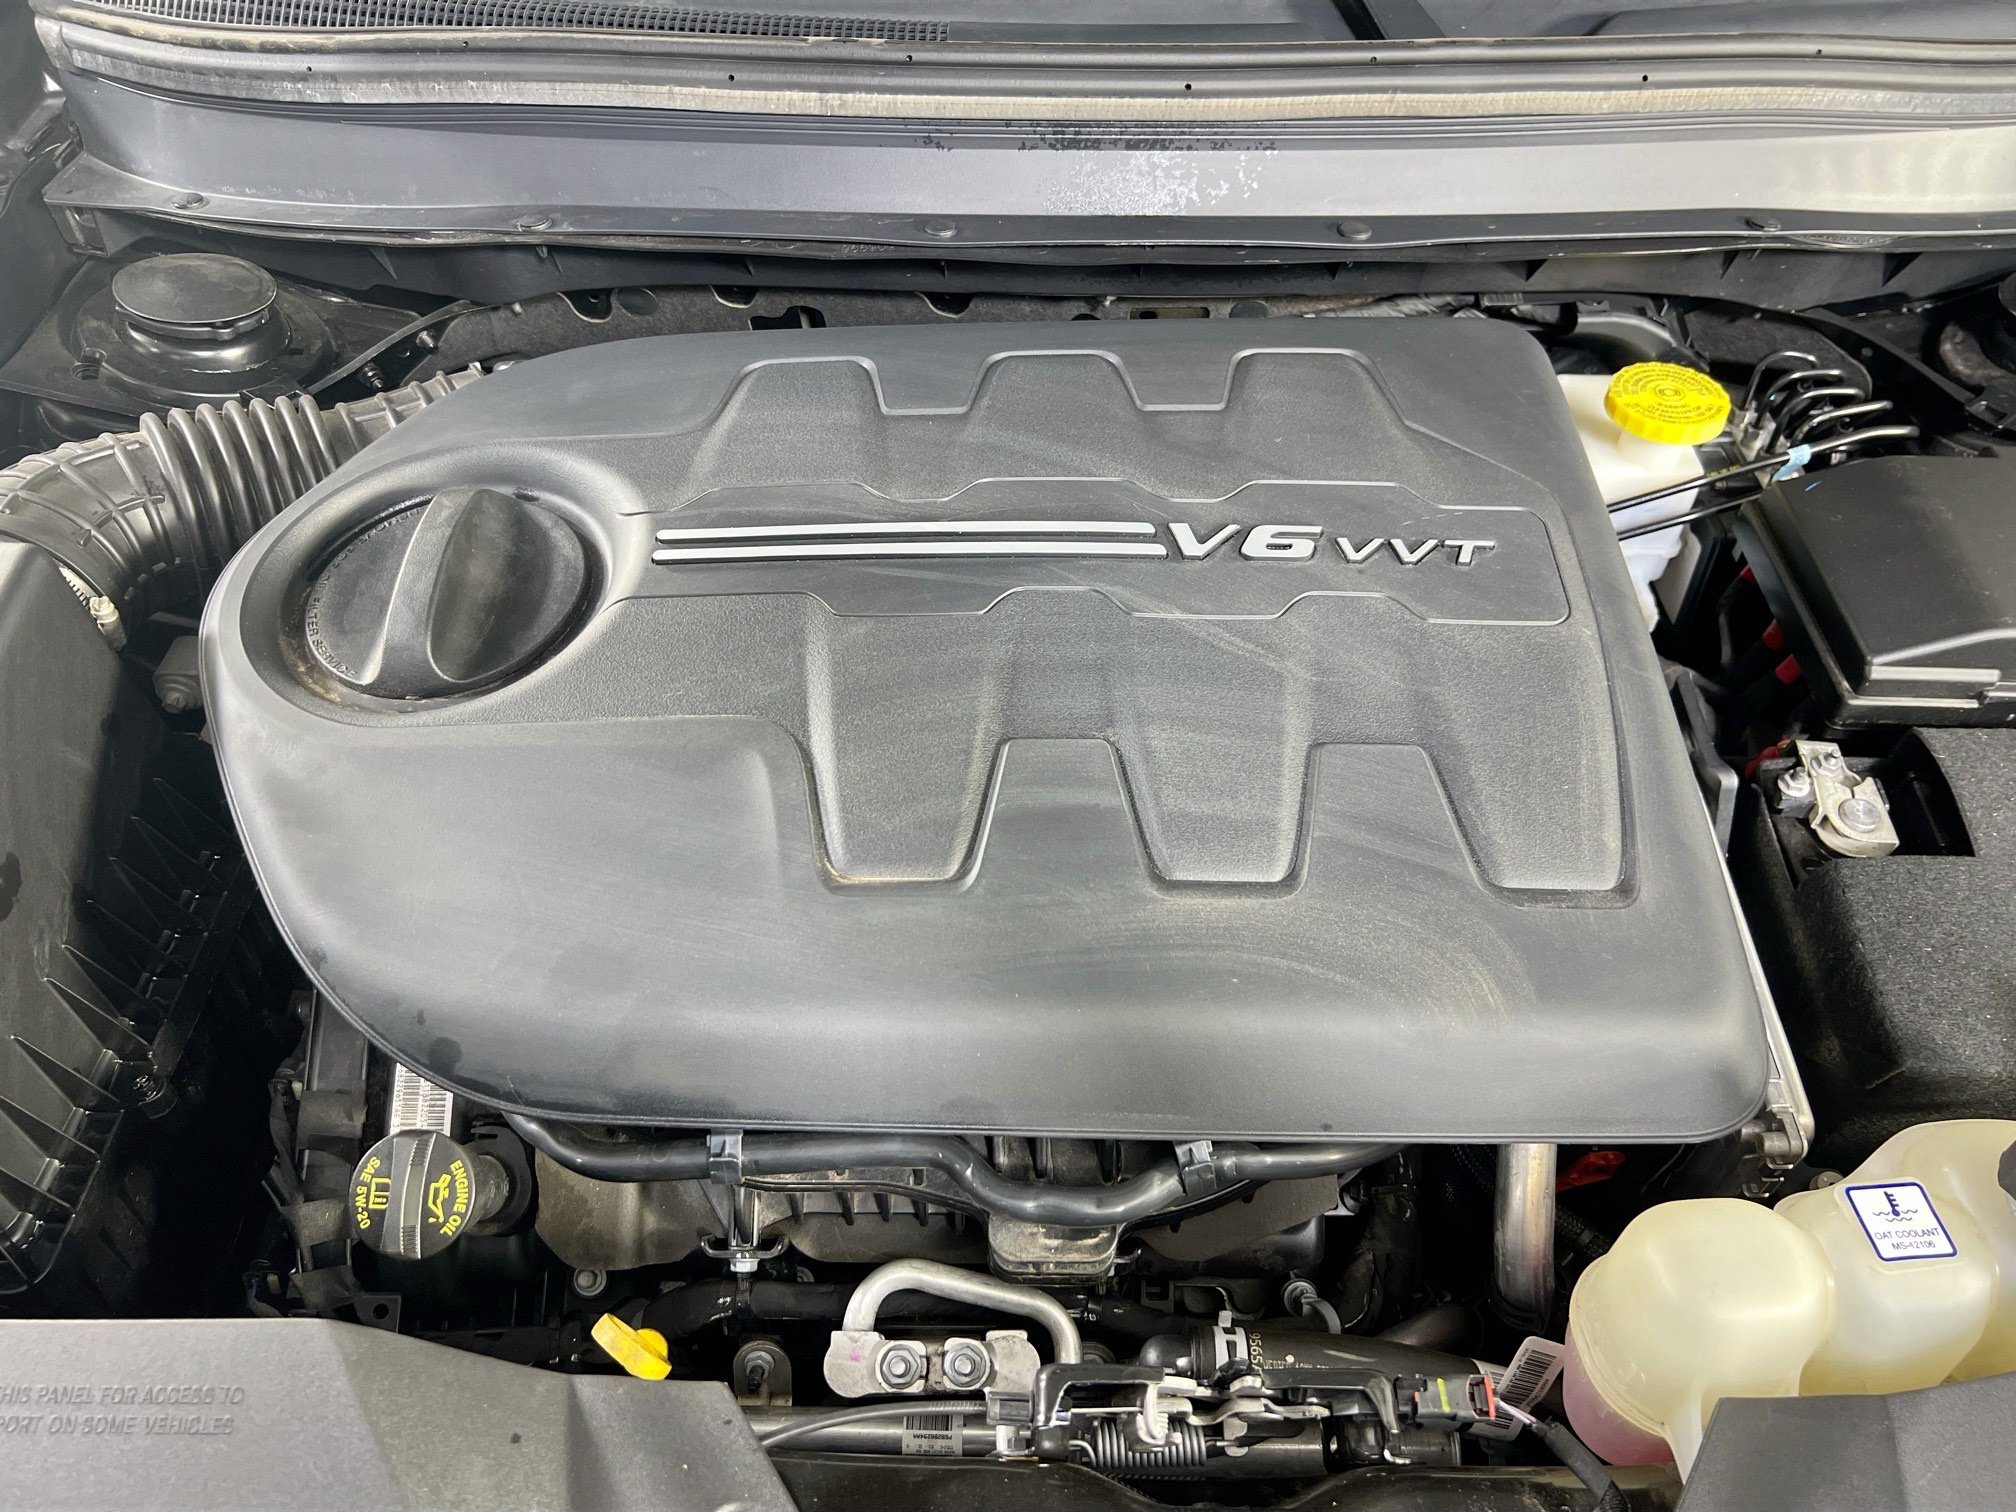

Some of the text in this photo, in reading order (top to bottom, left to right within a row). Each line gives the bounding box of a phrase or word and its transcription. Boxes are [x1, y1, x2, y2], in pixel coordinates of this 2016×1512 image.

[1167, 522, 1496, 567] V6 VVT
[306, 597, 321, 638] FILTER
[355, 1156, 381, 1230] SAE 5W-20
[439, 1159, 469, 1236] ENGINE OIL
[1874, 1227, 1940, 1241] OAT COOLANT
[1891, 1239, 1936, 1251] MS-12106
[37, 1384, 95, 1404] PANEL
[100, 1384, 138, 1405] FOR
[138, 1384, 216, 1405] ACCESS
[219, 1385, 246, 1405] TO
[48, 1415, 78, 1434] ON
[80, 1415, 138, 1434] SOME
[143, 1415, 236, 1435] VEHICLES
